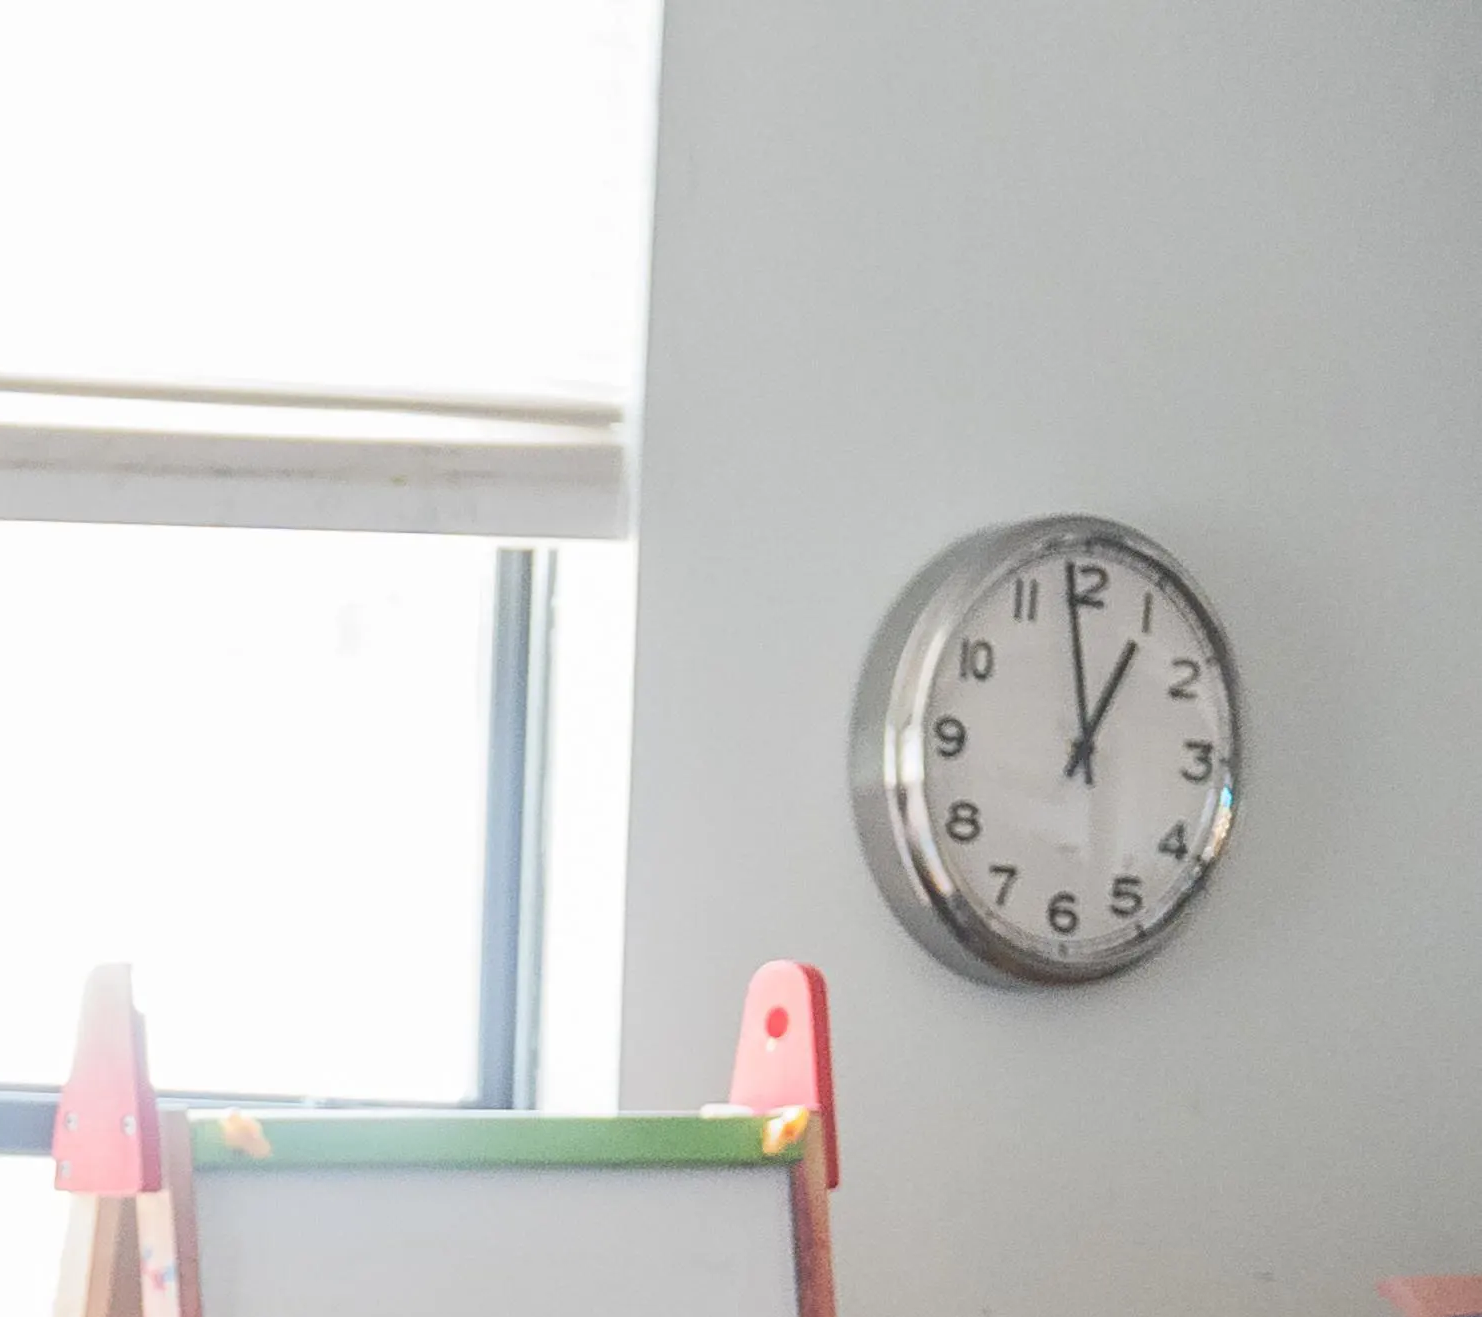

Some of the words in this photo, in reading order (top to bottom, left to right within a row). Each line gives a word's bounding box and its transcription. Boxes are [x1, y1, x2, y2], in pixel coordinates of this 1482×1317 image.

[1013, 580, 1038, 621] 11
[1142, 593, 1153, 633] 1
[960, 639, 995, 682] 10
[1168, 659, 1201, 700] 2
[934, 717, 967, 758] 9
[1181, 741, 1213, 782] 3
[946, 802, 981, 842] 8
[1158, 820, 1188, 860] 4
[989, 866, 1018, 906] 7
[1111, 876, 1144, 917] 5
[1047, 892, 1078, 934] 6
